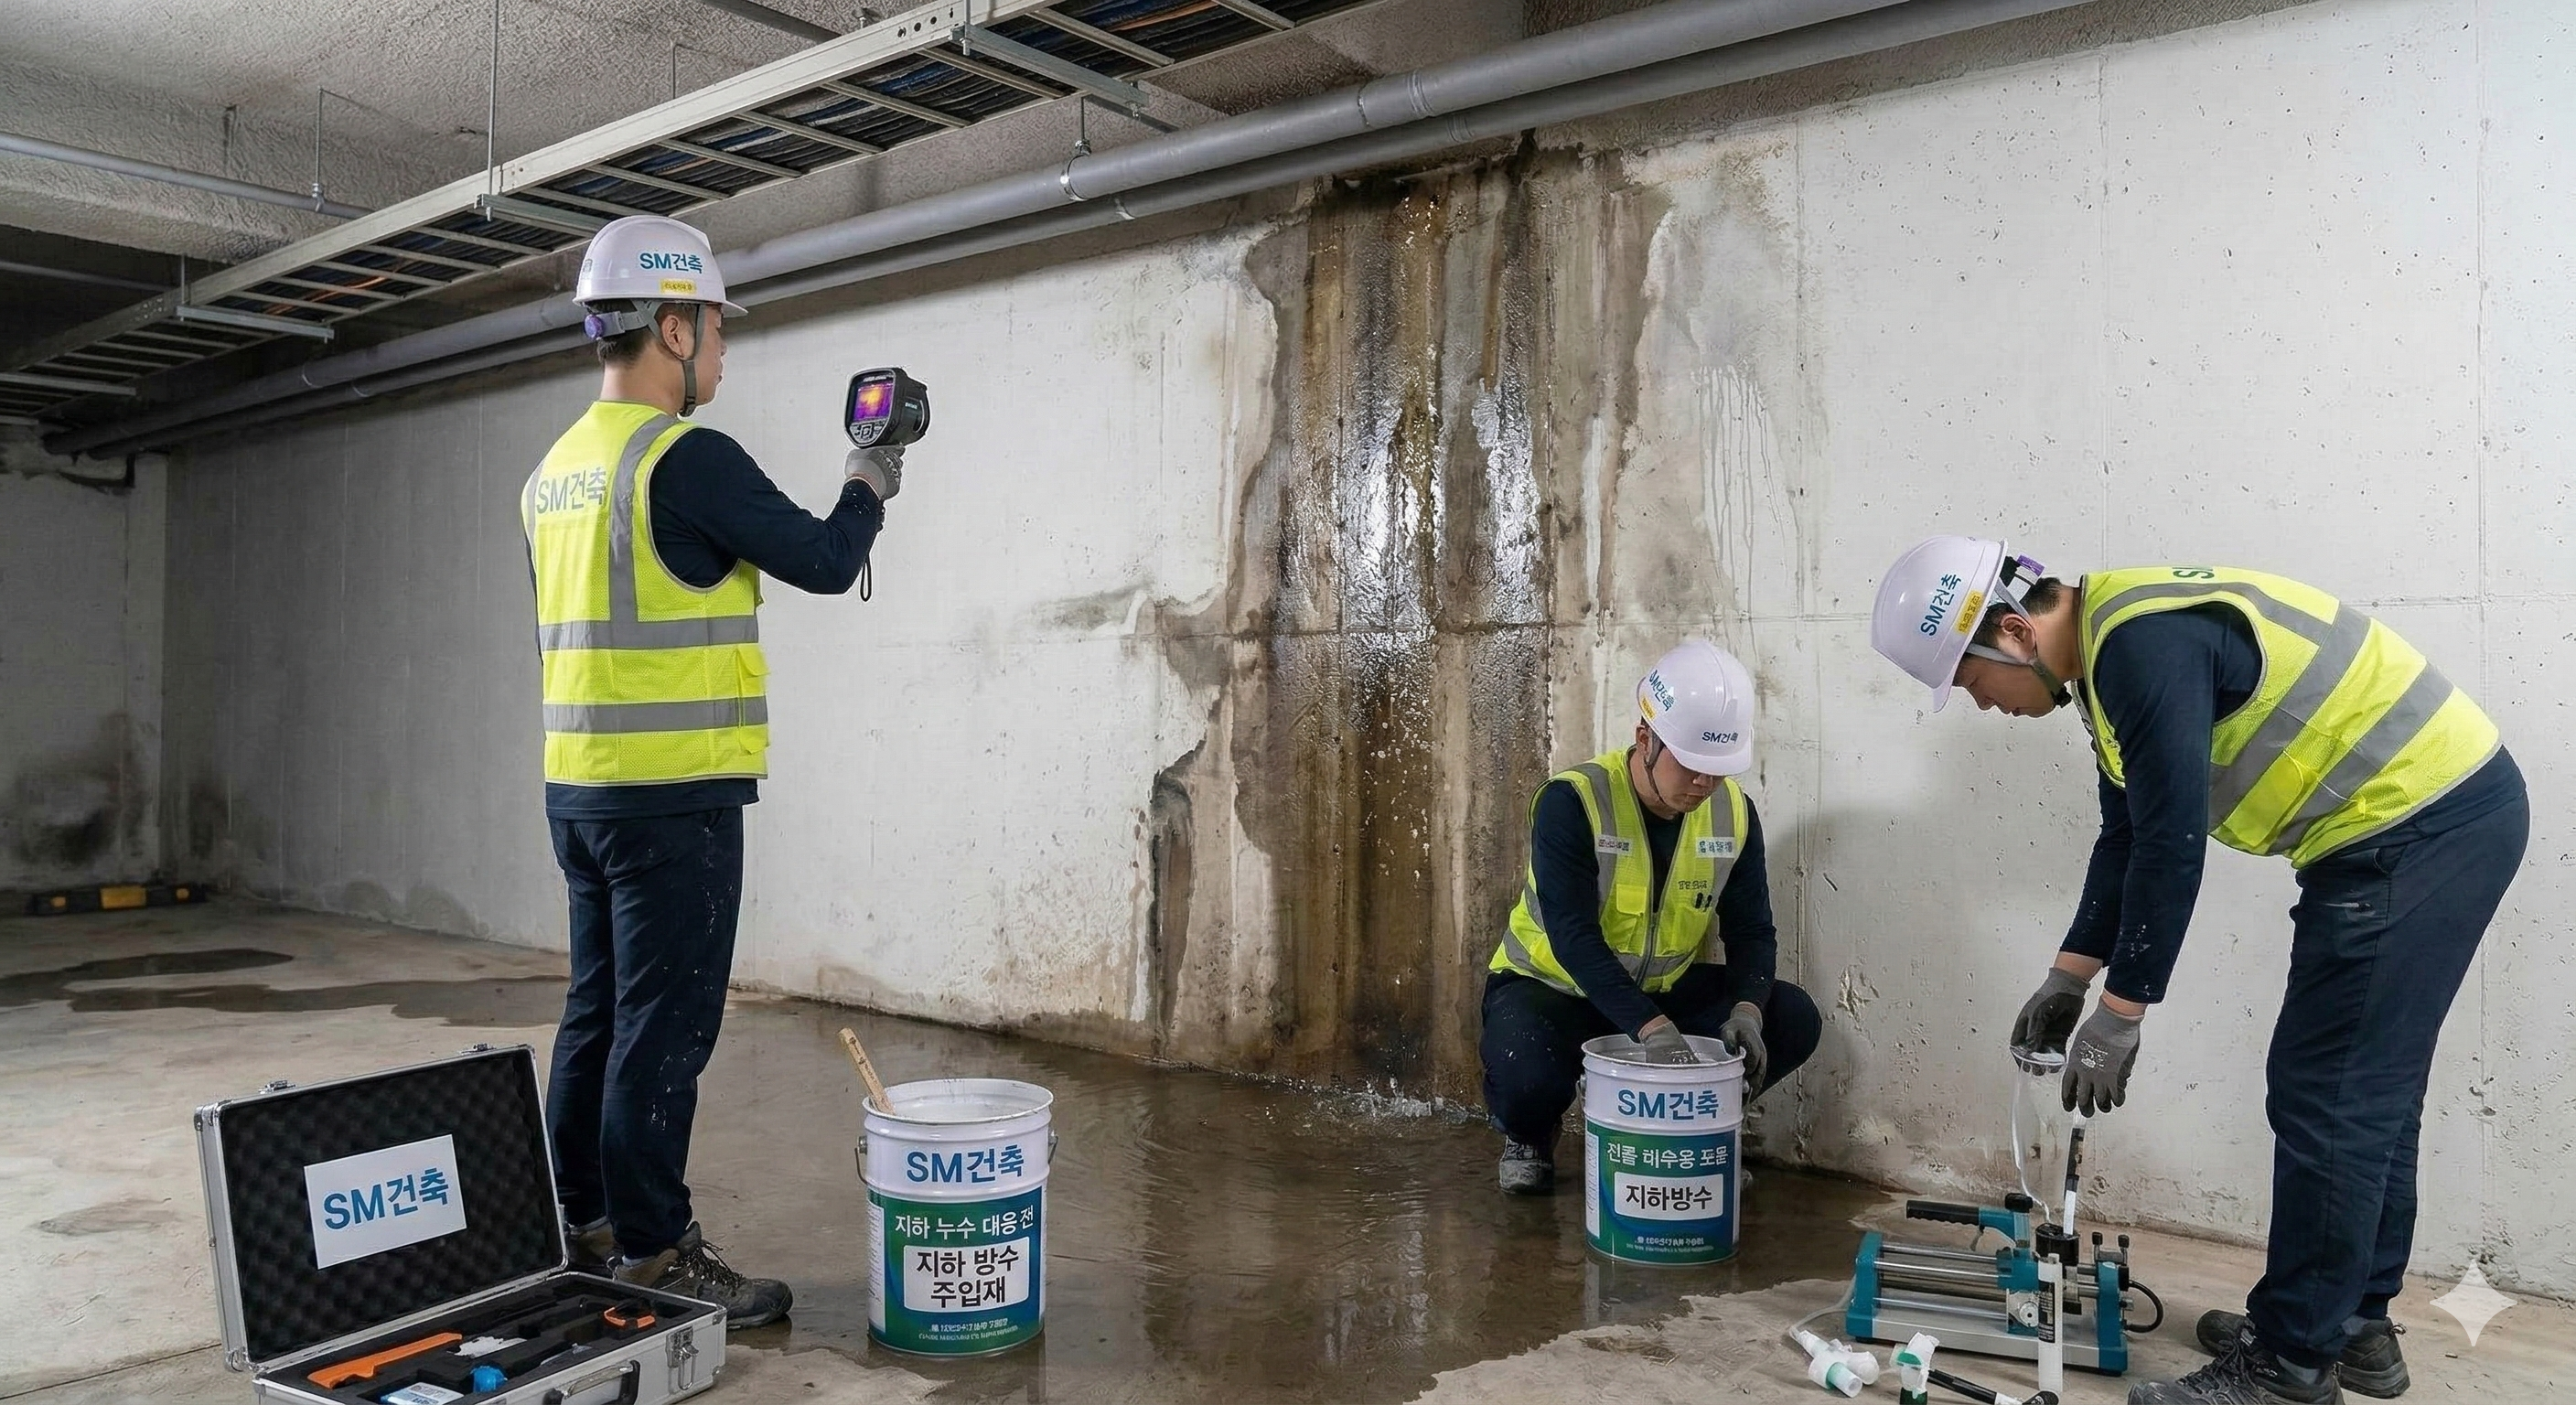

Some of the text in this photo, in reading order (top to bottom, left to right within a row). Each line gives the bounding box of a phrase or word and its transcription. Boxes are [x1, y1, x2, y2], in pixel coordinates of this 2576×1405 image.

[639, 252, 703, 274] SM건축
[536, 467, 606, 514] SM건축
[1920, 573, 1962, 637] SM건축
[1617, 1089, 1719, 1120] SM건축
[907, 1144, 1024, 1183] SM건축
[324, 1167, 449, 1229] SM건축
[1626, 1185, 1712, 1211] 지하방수
[896, 1215, 930, 1239] 지하
[936, 1217, 976, 1239] 누수
[917, 1245, 1019, 1278] 지하 방수
[930, 1276, 1005, 1308] 주입재
